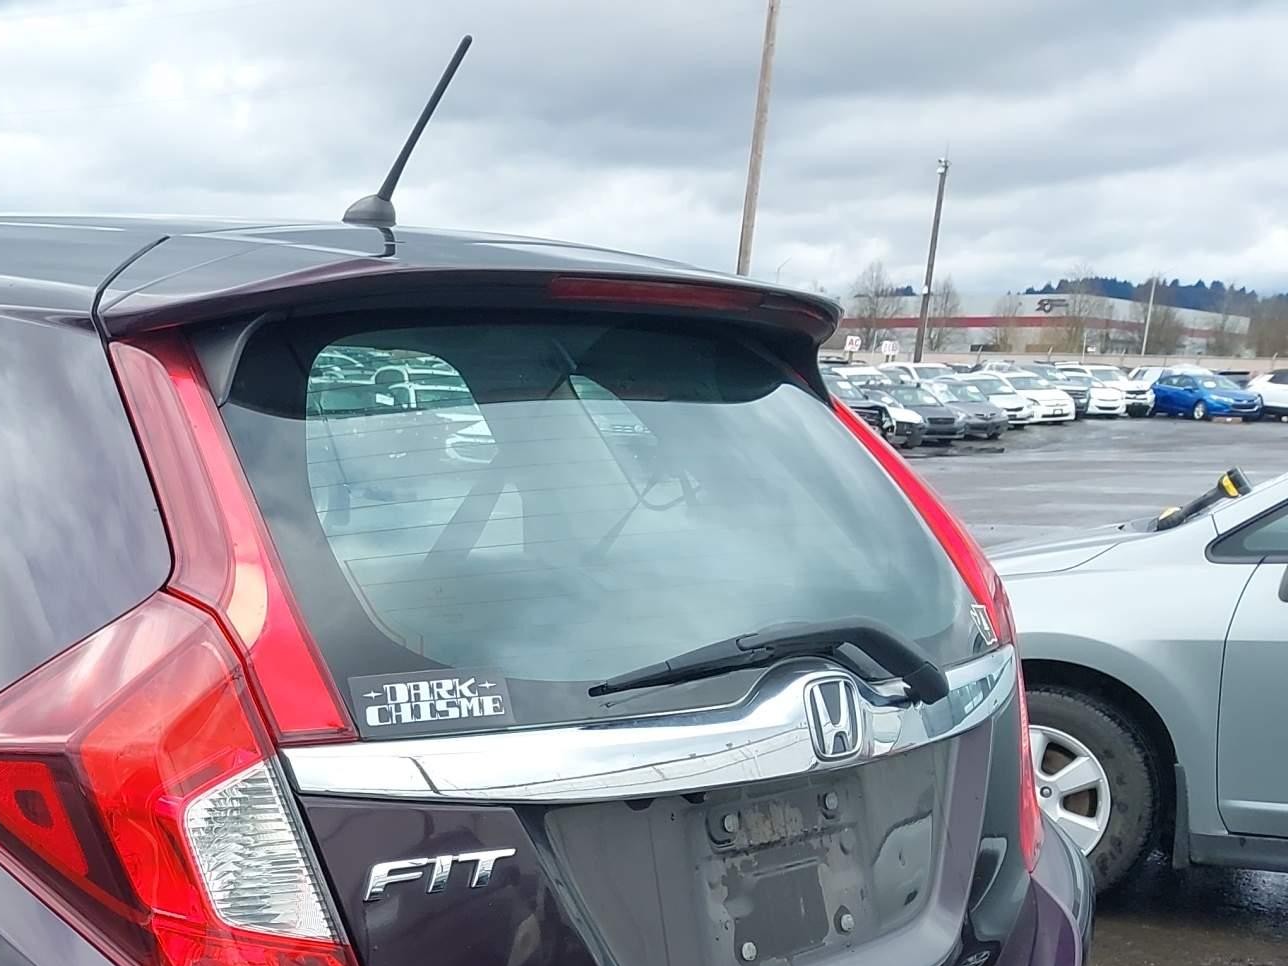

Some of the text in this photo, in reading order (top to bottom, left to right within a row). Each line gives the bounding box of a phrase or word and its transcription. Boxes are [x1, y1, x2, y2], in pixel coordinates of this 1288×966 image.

[383, 678, 479, 704] DARK
[365, 696, 505, 727] CHISME
[364, 848, 517, 902] FIT
